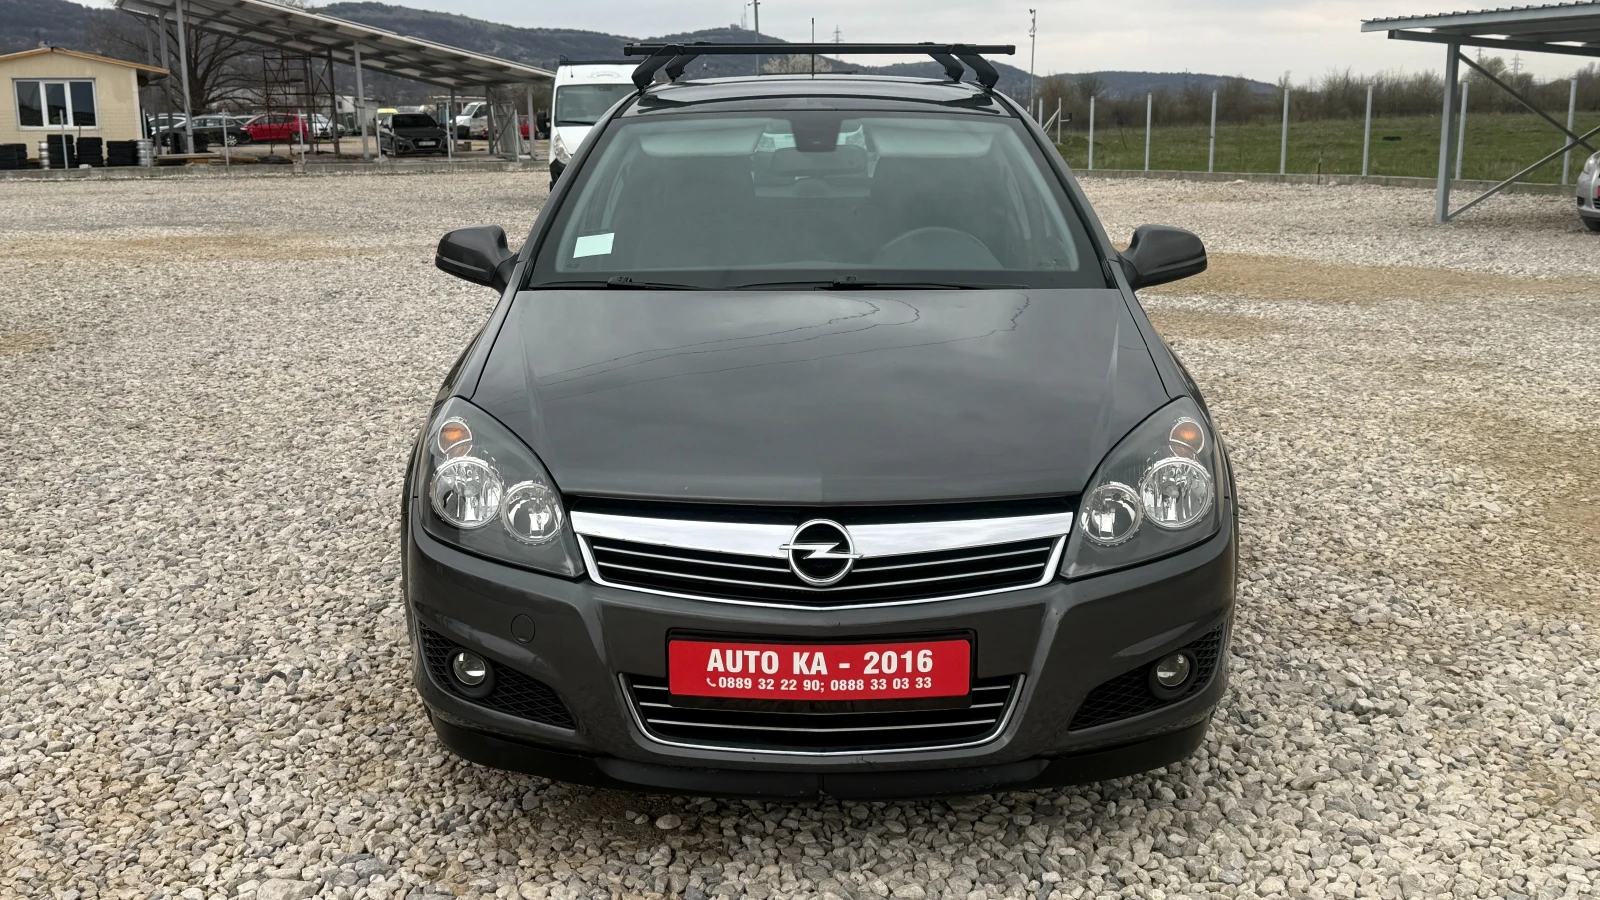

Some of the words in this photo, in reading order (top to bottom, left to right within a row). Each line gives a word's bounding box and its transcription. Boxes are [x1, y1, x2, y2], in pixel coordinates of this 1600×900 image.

[706, 648, 779, 674] AUTO
[792, 651, 828, 675] KA
[863, 649, 933, 674] 2016
[718, 677, 752, 689] 0889
[757, 678, 775, 690] 32
[780, 679, 797, 691] 22
[803, 680, 825, 693] 90;
[830, 679, 865, 691] 0888
[870, 678, 887, 690] 33
[892, 678, 910, 690] 03
[915, 677, 932, 689] 33
